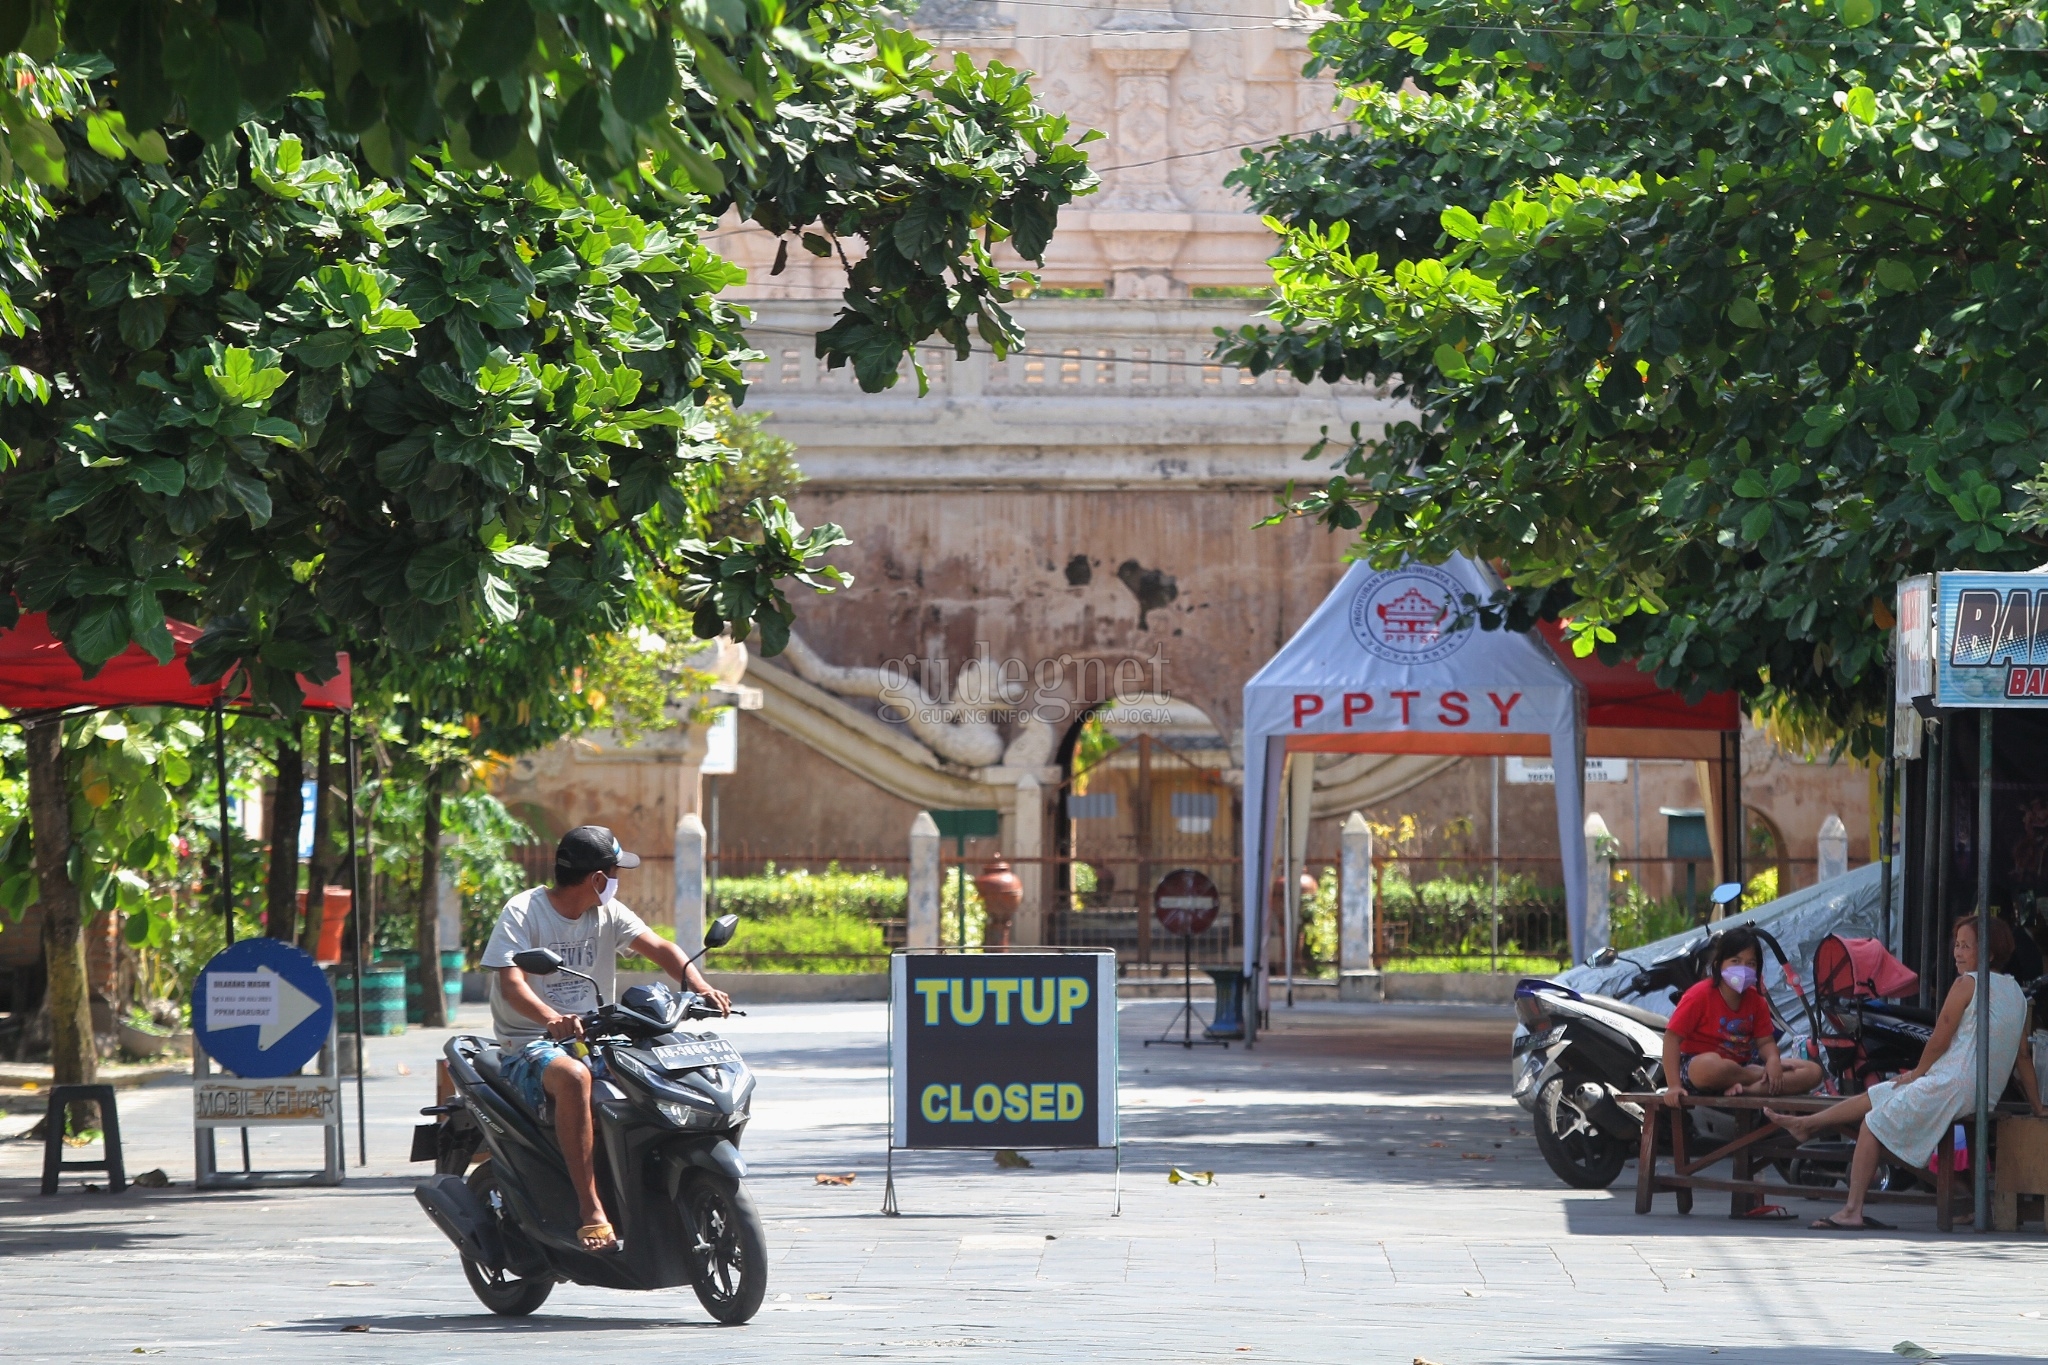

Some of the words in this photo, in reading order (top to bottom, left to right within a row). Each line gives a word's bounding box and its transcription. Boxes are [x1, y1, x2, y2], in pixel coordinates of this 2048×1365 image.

[1353, 578, 1381, 627] PAGUYUBAN
[1367, 641, 1456, 662] YOGYAKARTA
[1384, 634, 1440, 644] PPTSY
[1293, 690, 1523, 729] PPTSY
[247, 980, 271, 989] MASUK
[213, 1008, 235, 1017] PPKM
[236, 1008, 270, 1017] DARURAT
[915, 977, 1090, 1026] TUTUP
[199, 1091, 255, 1117] MOBIL
[263, 1090, 335, 1115] KELUAR
[921, 1082, 1084, 1124] CLOSED
